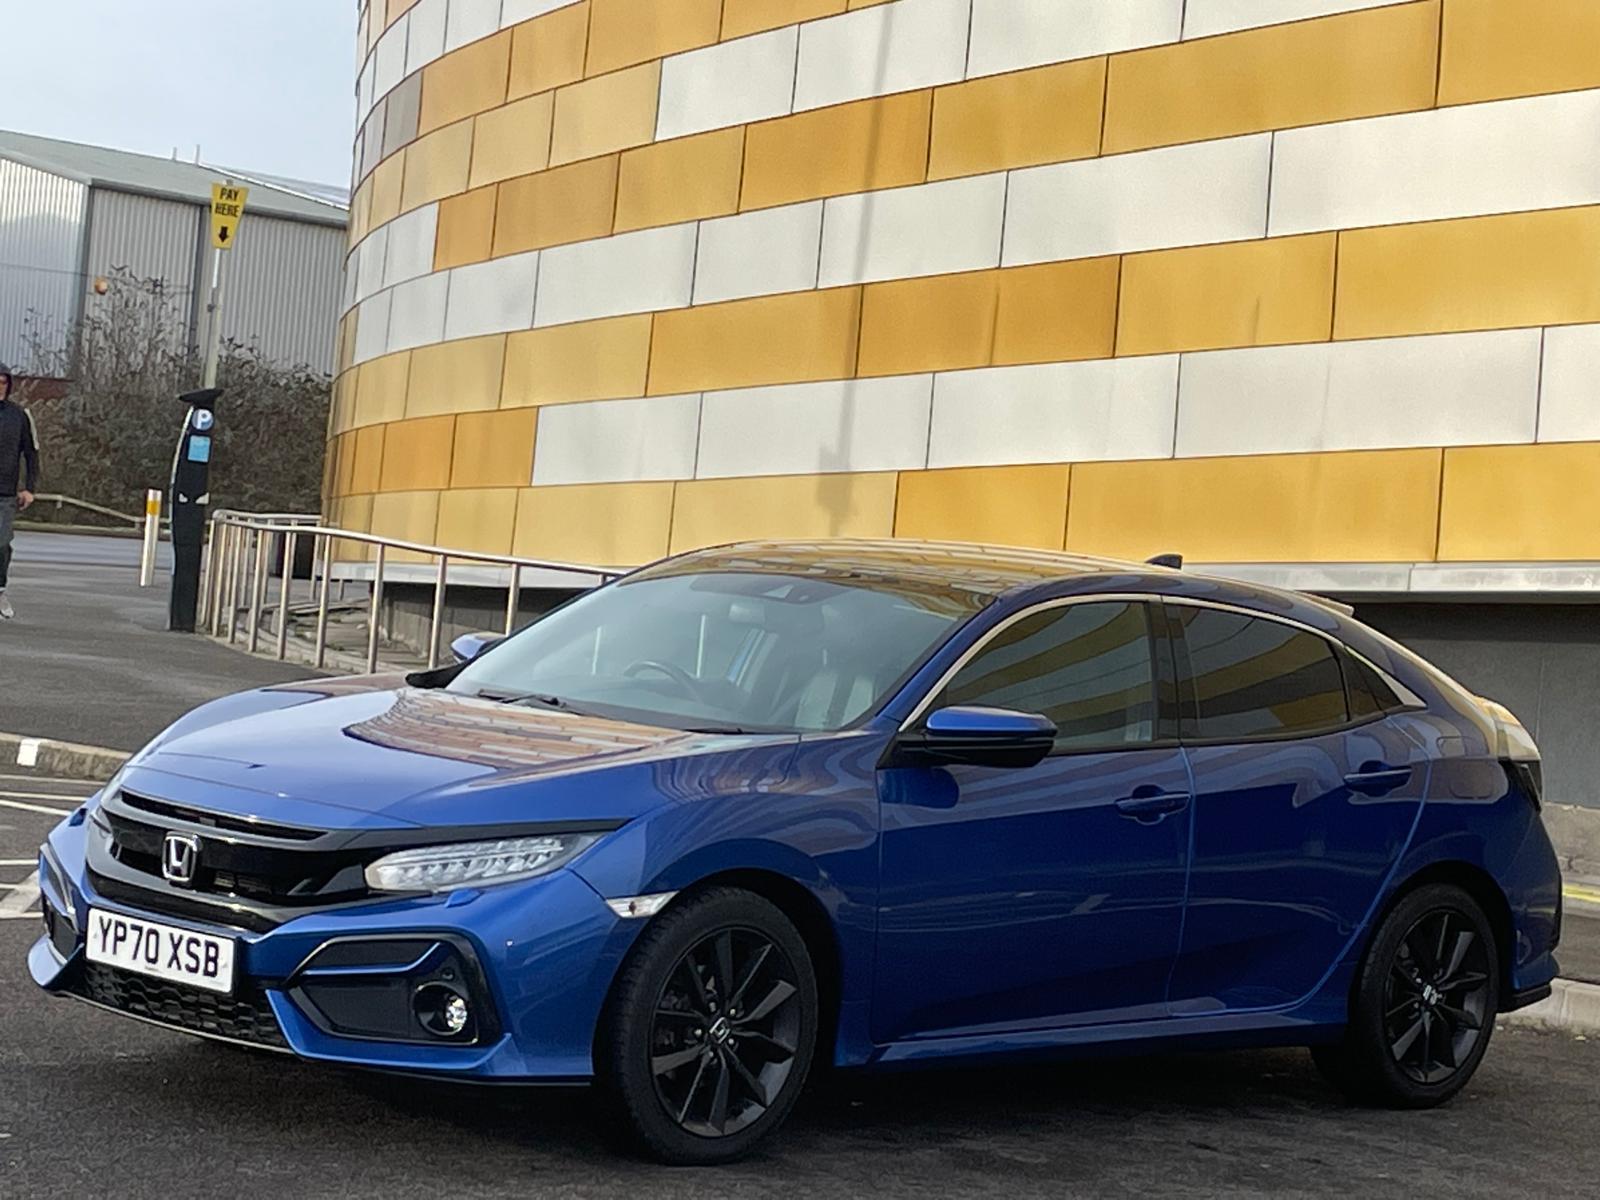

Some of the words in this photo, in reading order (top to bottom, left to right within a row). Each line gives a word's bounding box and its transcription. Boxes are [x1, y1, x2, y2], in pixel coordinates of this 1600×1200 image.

[219, 187, 240, 201] PAY
[215, 202, 240, 218] HERE
[197, 408, 213, 430] P
[99, 915, 160, 965] YP70
[167, 932, 219, 978] XSB
